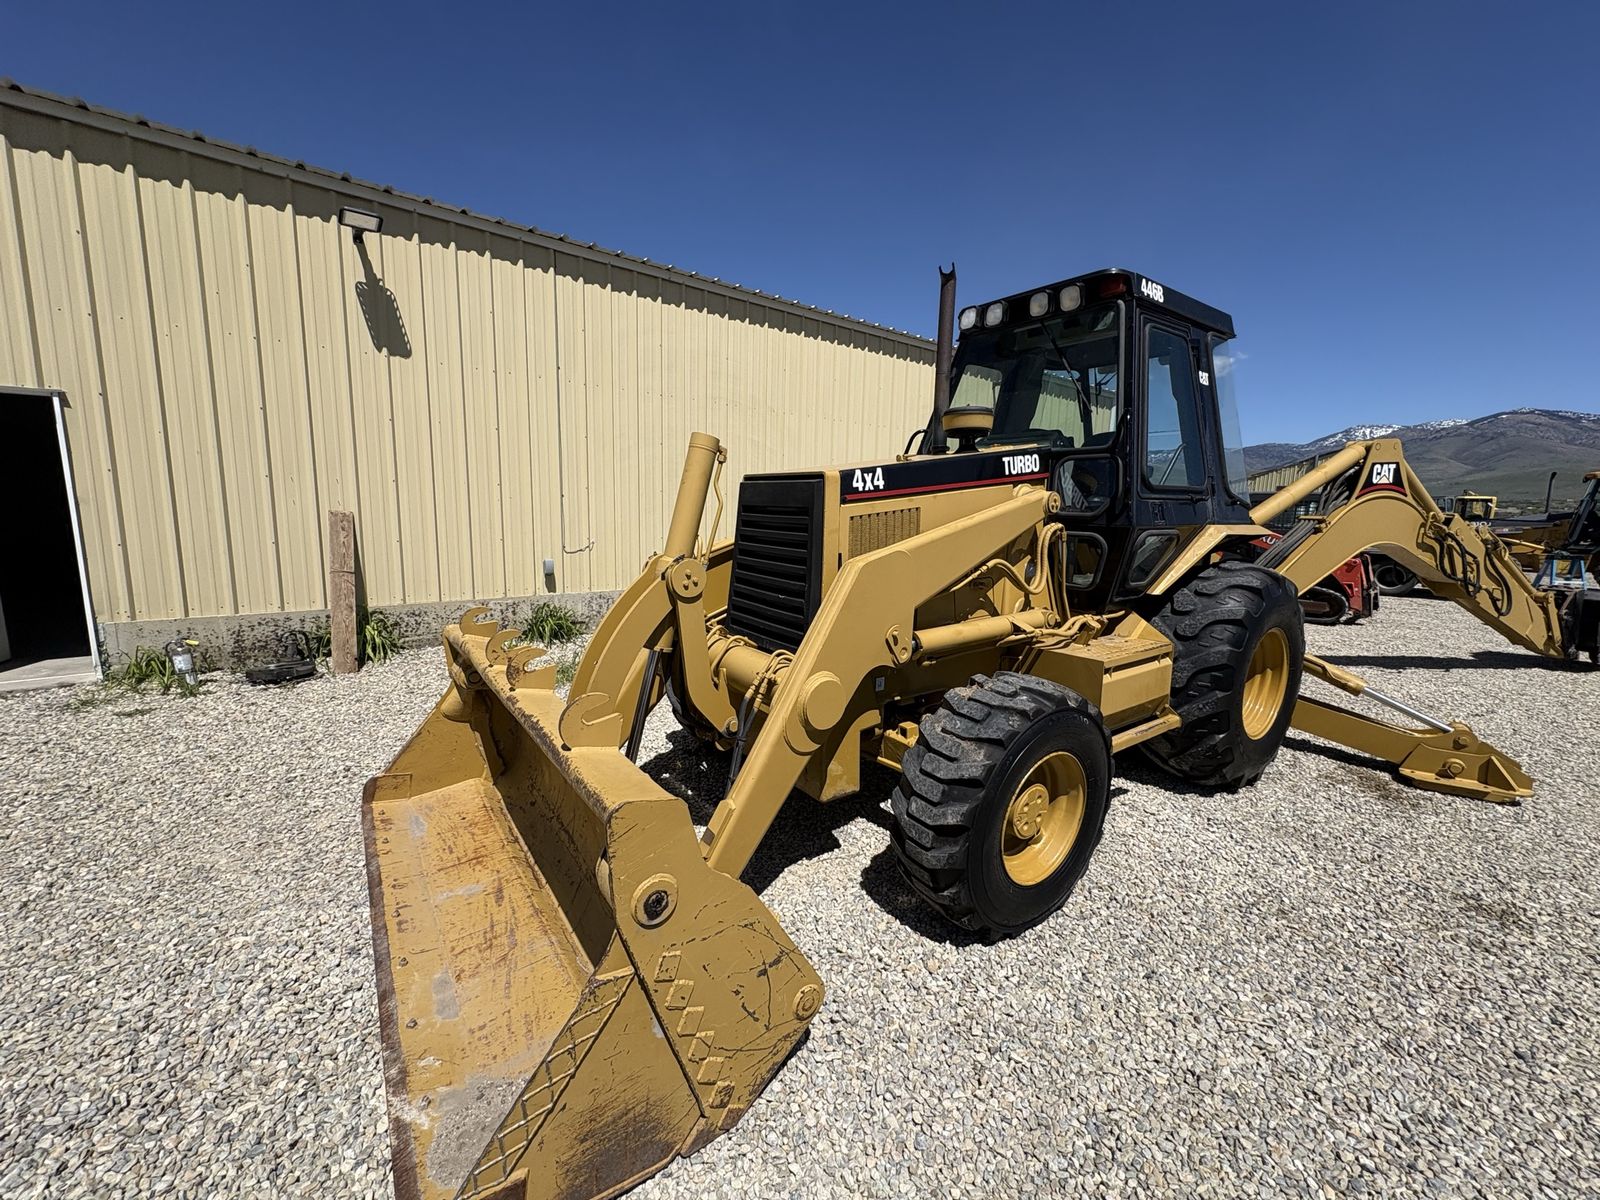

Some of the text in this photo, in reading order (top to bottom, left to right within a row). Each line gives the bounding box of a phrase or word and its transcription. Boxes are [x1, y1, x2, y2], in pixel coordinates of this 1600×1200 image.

[1141, 278, 1164, 303] 446B
[1198, 371, 1209, 386] CAT
[1002, 454, 1040, 475] TURBO
[1372, 463, 1397, 484] CAT
[852, 467, 885, 492] 4x4
